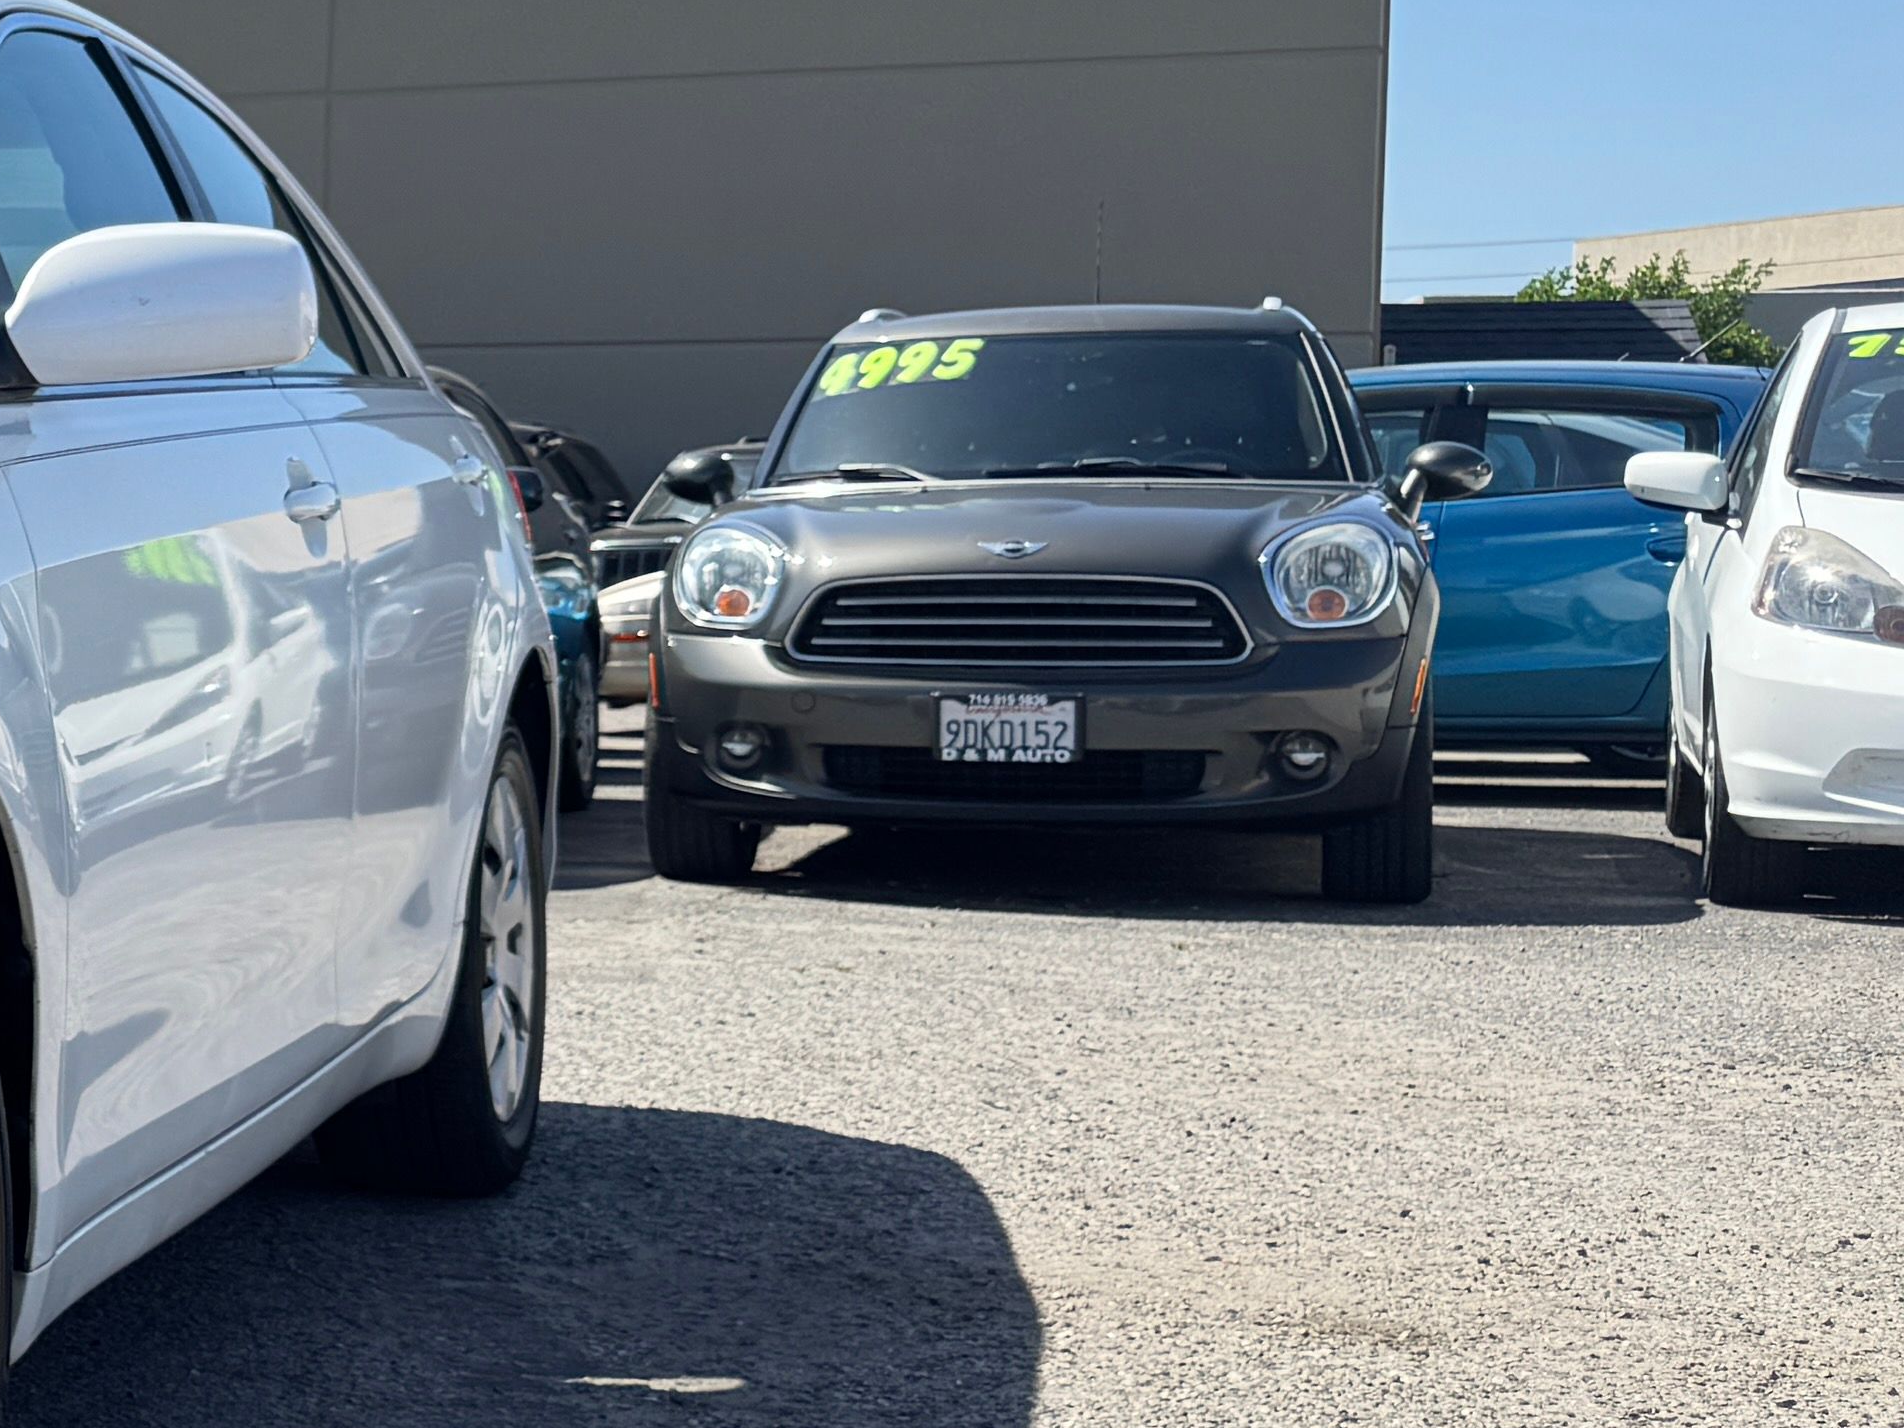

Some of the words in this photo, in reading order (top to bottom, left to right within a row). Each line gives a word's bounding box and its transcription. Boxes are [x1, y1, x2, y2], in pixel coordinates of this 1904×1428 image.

[1848, 333, 1904, 358] 7
[945, 719, 1068, 750] 9DKD152
[942, 748, 958, 762] D
[963, 748, 980, 762] &
[986, 748, 1007, 762] M
[1012, 748, 1071, 763] AUTO
